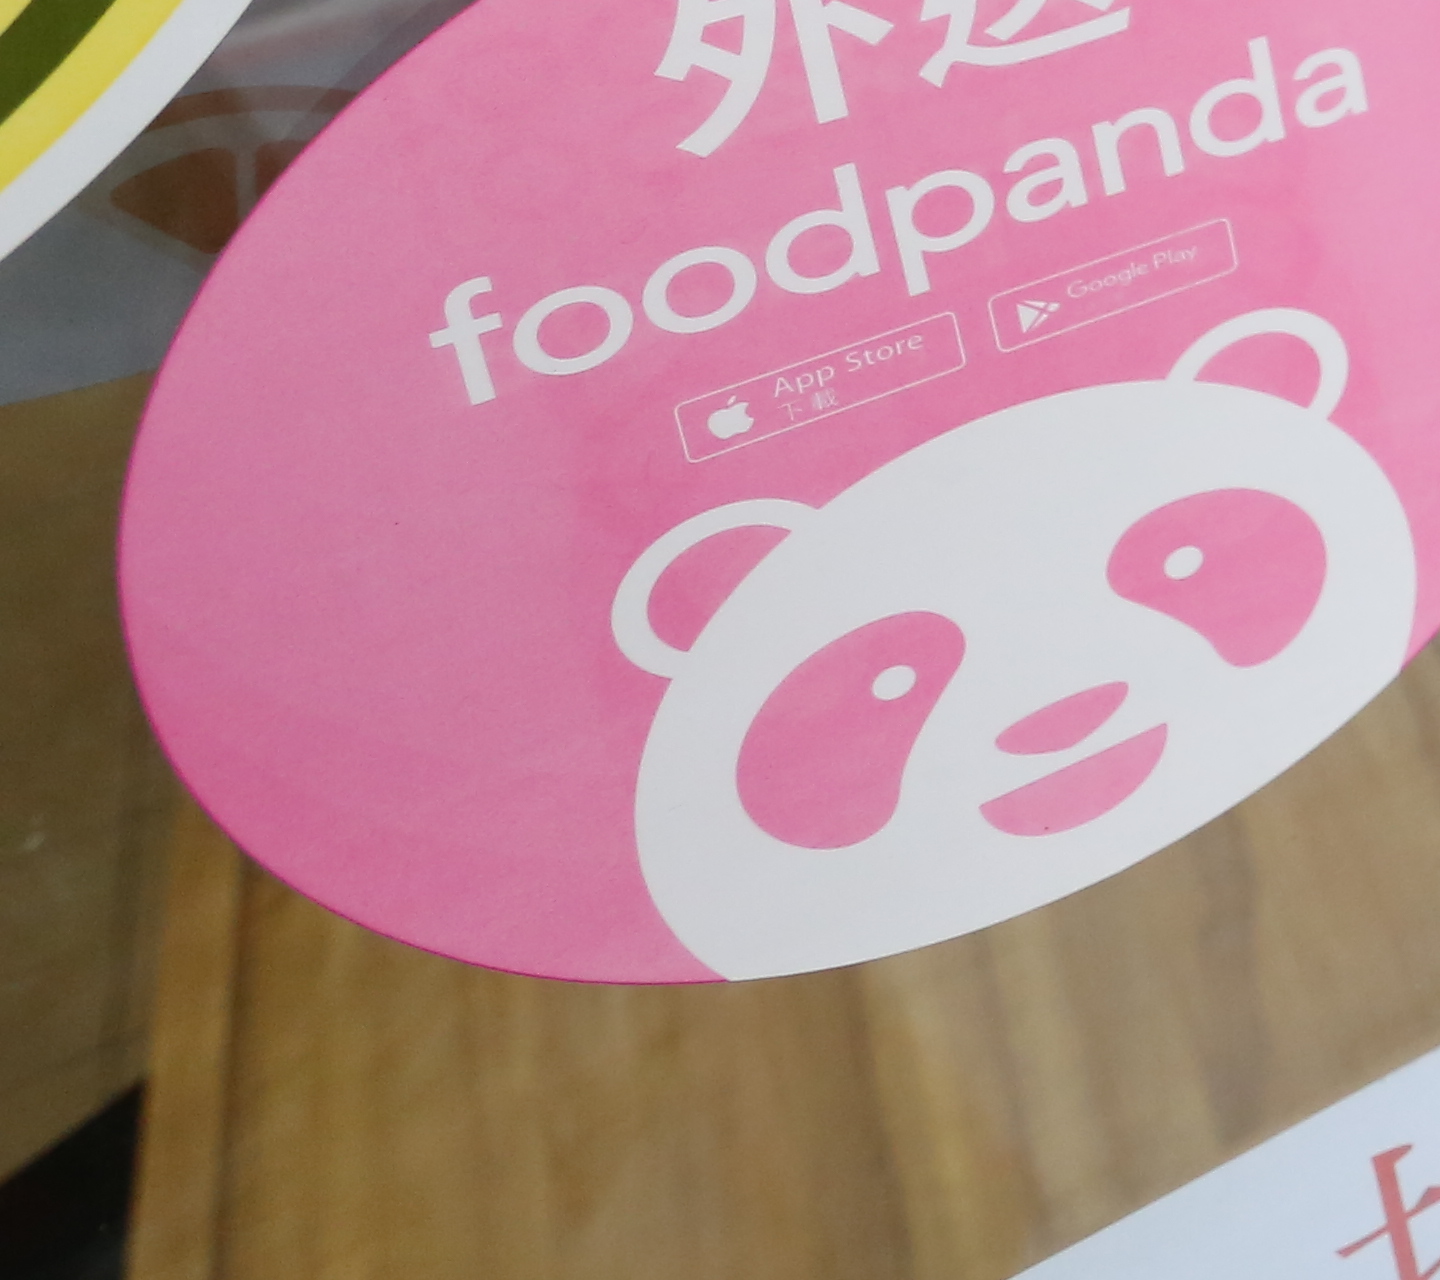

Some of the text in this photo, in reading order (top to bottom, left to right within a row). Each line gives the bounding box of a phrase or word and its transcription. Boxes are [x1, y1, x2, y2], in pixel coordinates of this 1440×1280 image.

[427, 35, 1371, 406] foodpanda
[1065, 244, 1199, 299] Google Play
[772, 329, 926, 400] App Store
